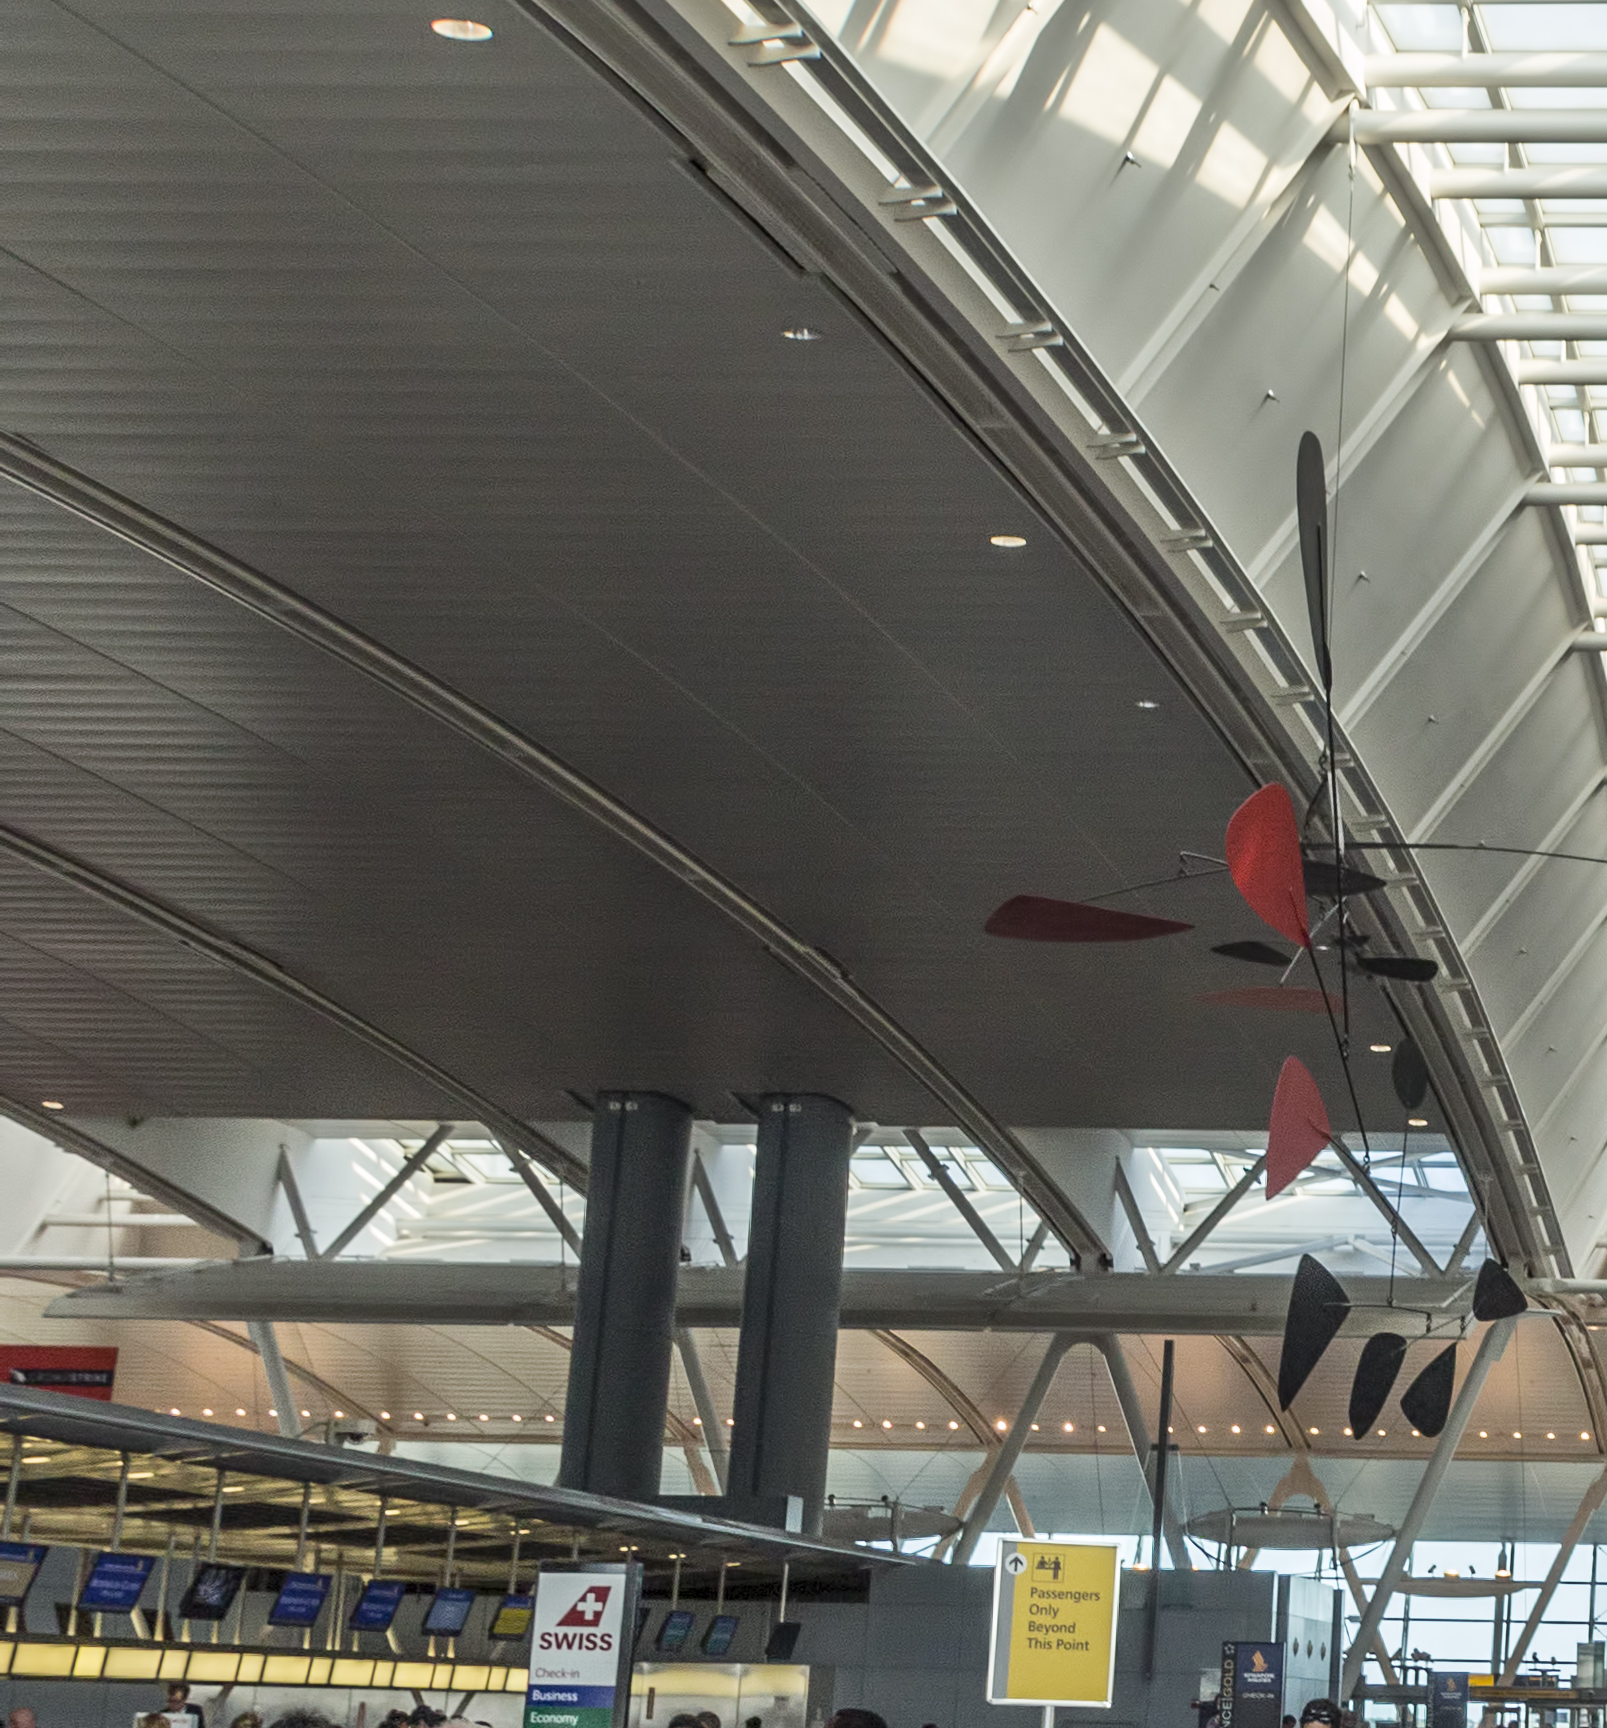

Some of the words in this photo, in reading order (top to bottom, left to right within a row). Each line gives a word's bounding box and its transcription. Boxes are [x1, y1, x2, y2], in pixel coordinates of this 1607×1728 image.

[1030, 1587, 1100, 1603] Passengers
[1029, 1603, 1059, 1618] Only
[1028, 1621, 1076, 1635] Beyond
[539, 1632, 613, 1651] SWISS
[1027, 1637, 1052, 1650] This
[1056, 1638, 1090, 1651] Point
[535, 1667, 580, 1679] Check-in
[532, 1689, 579, 1702] Business
[530, 1711, 579, 1726] Economy
